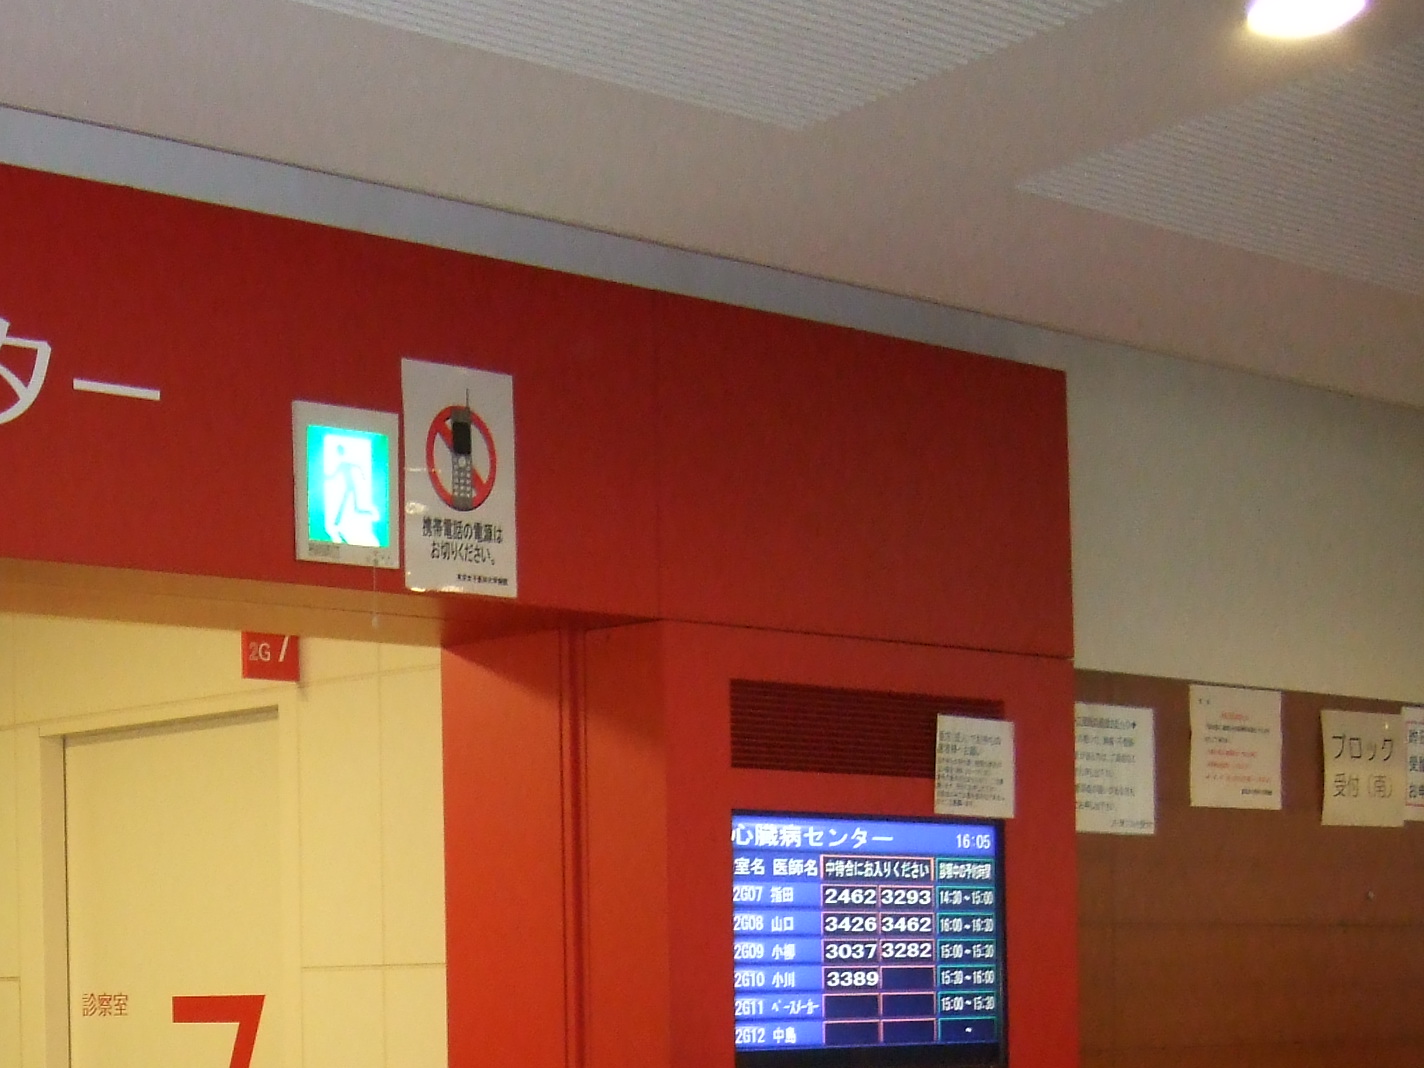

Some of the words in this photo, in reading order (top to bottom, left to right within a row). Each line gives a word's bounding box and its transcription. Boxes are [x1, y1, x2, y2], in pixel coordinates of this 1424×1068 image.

[731, 824, 894, 849] 心臓病センター
[955, 832, 991, 850] 16:05
[734, 857, 765, 875] 室名
[773, 858, 818, 876] 医師名
[733, 886, 763, 902] 2G07
[825, 889, 877, 905] 2462
[881, 889, 932, 905] 3293
[733, 916, 764, 931] 2G08
[771, 916, 794, 931] 山口
[825, 916, 877, 933] 3426
[881, 916, 932, 932] 3462
[734, 944, 765, 960] 2G09
[825, 943, 877, 960] 3037
[881, 943, 933, 958] 3282
[734, 971, 765, 988] 2G10
[772, 971, 796, 988] 小川
[827, 971, 879, 987] 3389
[82, 993, 128, 1017] 診察室
[735, 999, 764, 1015] 2G11
[735, 1026, 766, 1043] 2G12
